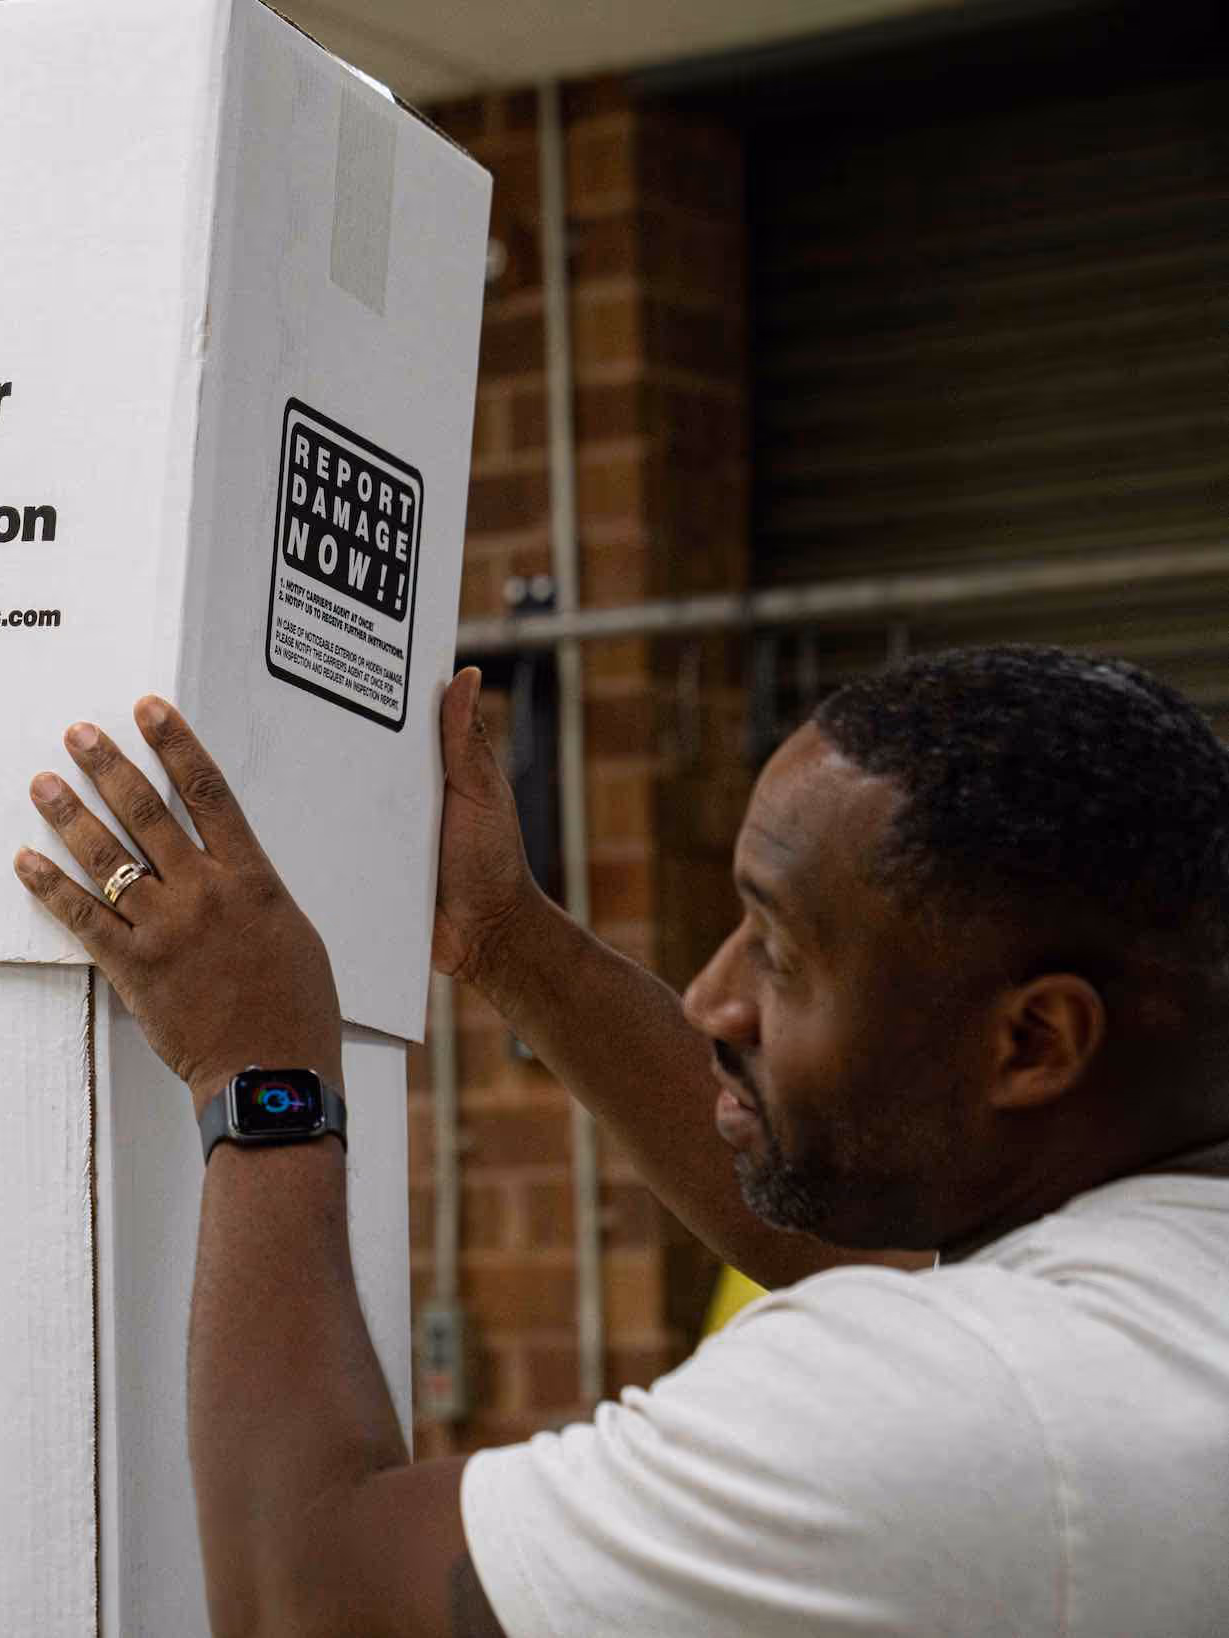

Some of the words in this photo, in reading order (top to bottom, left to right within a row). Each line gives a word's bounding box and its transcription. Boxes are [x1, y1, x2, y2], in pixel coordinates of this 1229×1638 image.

[294, 434, 412, 525] REPORT
[291, 473, 409, 562] DAMAGE
[287, 516, 405, 611] NOW!!
[285, 593, 304, 611] NOTIFY
[304, 602, 312, 615] US
[313, 607, 321, 619] TO
[322, 611, 343, 630] RECEIVE
[344, 622, 367, 642] FURTHER
[286, 579, 306, 598] NOTIFY
[333, 603, 350, 620] AGENT
[351, 612, 358, 623] AT
[275, 630, 294, 648] PLEASE
[295, 640, 312, 656] NOTIFY
[313, 648, 322, 661] THE
[348, 665, 363, 681] AGENT
[364, 673, 370, 683] AT
[370, 676, 383, 690] ONCE
[384, 682, 394, 694] FOR
[275, 644, 282, 656] AN
[283, 649, 312, 670] INSPECTION
[312, 662, 322, 674] AND
[323, 667, 344, 684] REQUEST
[345, 678, 352, 689] AN
[353, 681, 380, 701] INSPECTION
[276, 616, 282, 627] IN
[283, 620, 296, 634] CASE
[297, 627, 304, 637] OF
[305, 630, 334, 653] NOTICEABLE
[334, 645, 357, 663] EXTERIOR
[357, 656, 365, 667] OR
[365, 660, 383, 675] HIDDEN
